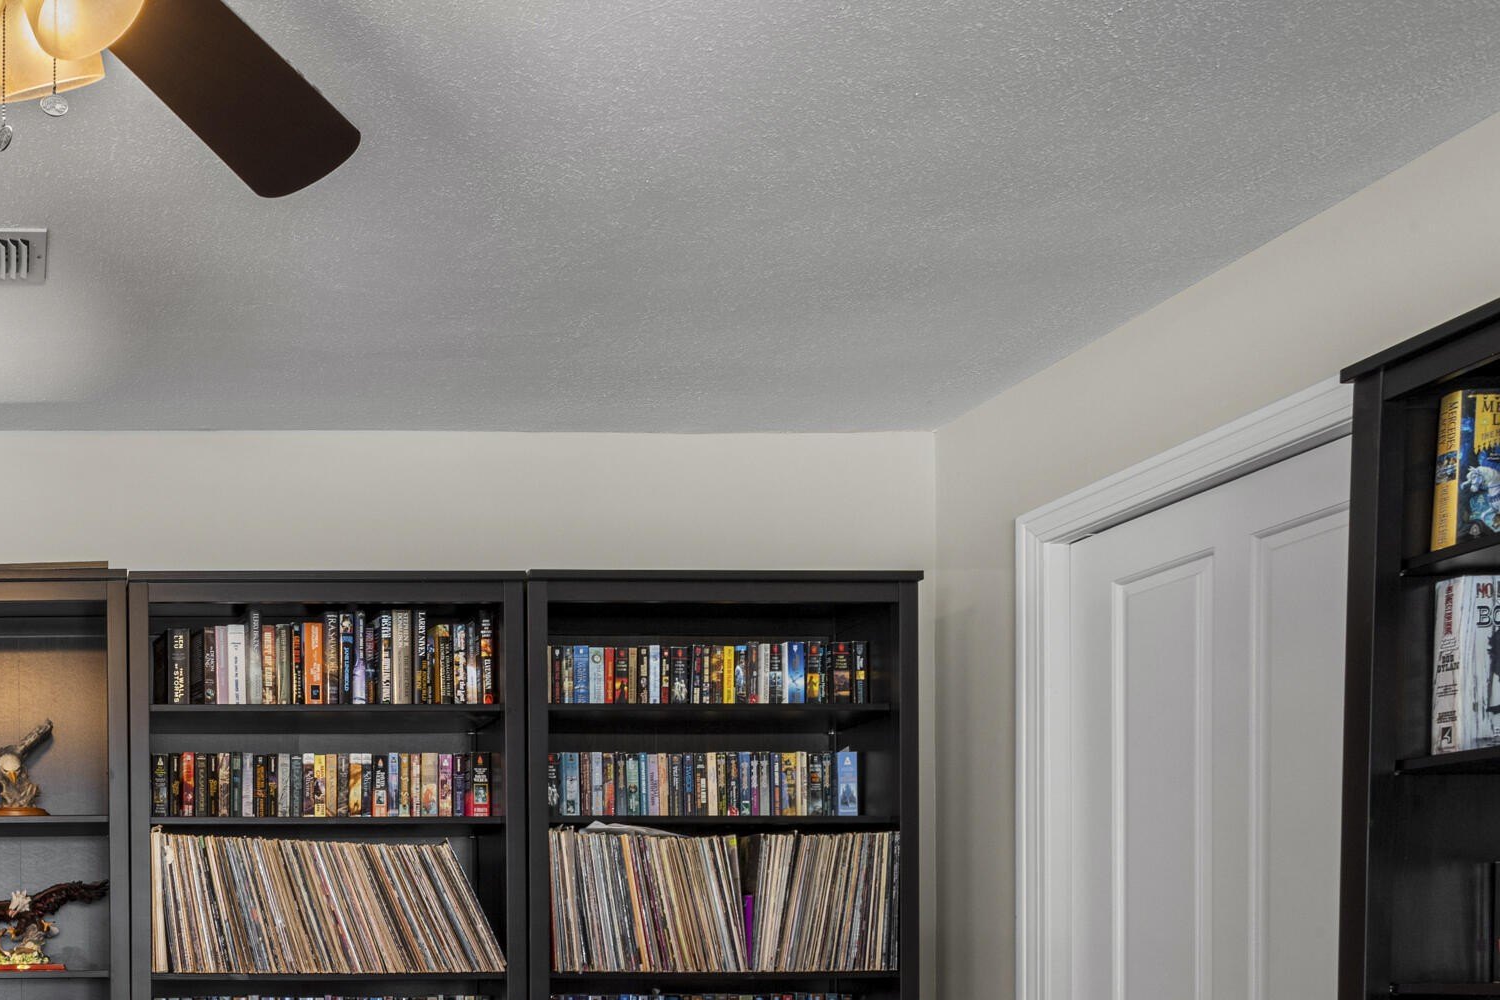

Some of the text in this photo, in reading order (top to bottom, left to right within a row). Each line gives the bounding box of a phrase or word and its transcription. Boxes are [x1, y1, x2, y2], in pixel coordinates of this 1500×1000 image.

[1476, 582, 1494, 598] NO
[418, 612, 426, 657] LARRY NIVEN
[1437, 662, 1460, 673] DYLAN
